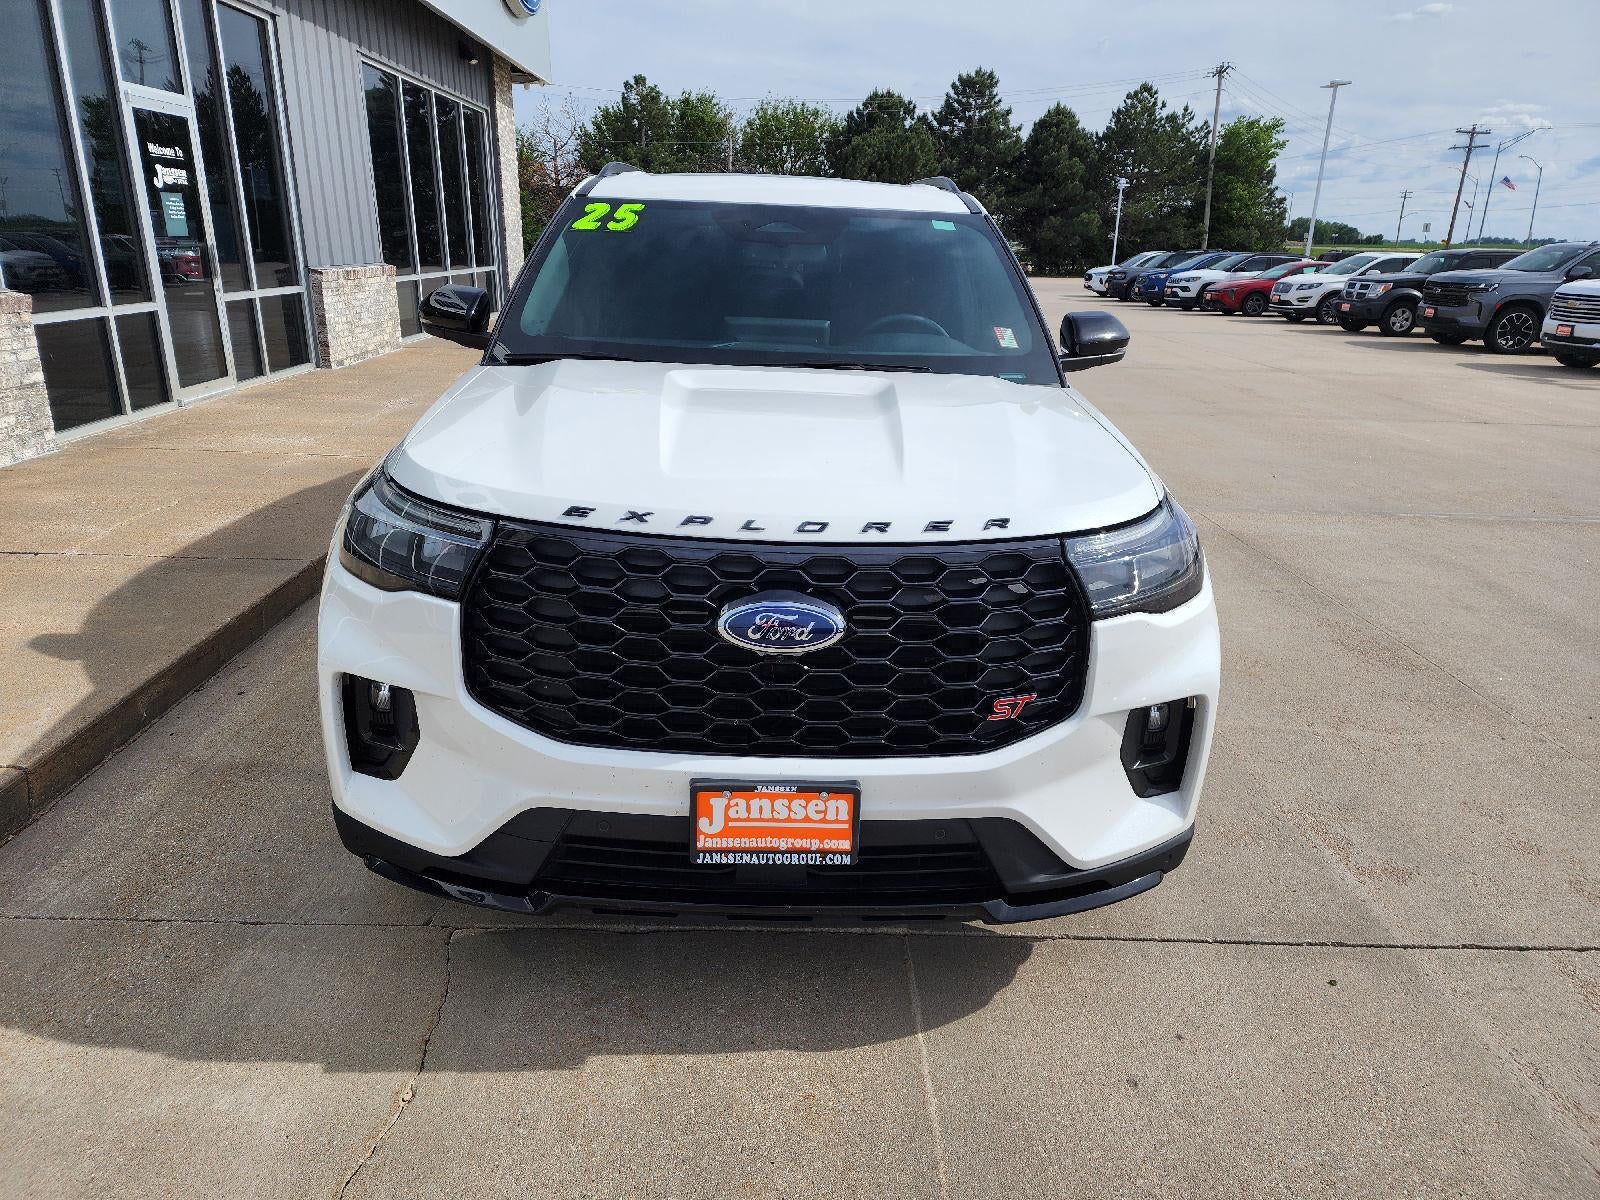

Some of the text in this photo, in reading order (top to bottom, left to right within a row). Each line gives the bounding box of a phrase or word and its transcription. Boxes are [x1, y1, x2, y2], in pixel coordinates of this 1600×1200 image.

[147, 142, 184, 157] Welcome To
[153, 163, 188, 188] Janssen
[571, 202, 646, 231] 25
[562, 505, 1011, 533] EXPLORER
[747, 612, 816, 641] Ford
[987, 694, 1037, 720] ST
[699, 797, 849, 834] Janssen
[696, 834, 851, 850] Janssenautogroup.com
[696, 852, 851, 865] JANSSENAUTOGROUP.COM
